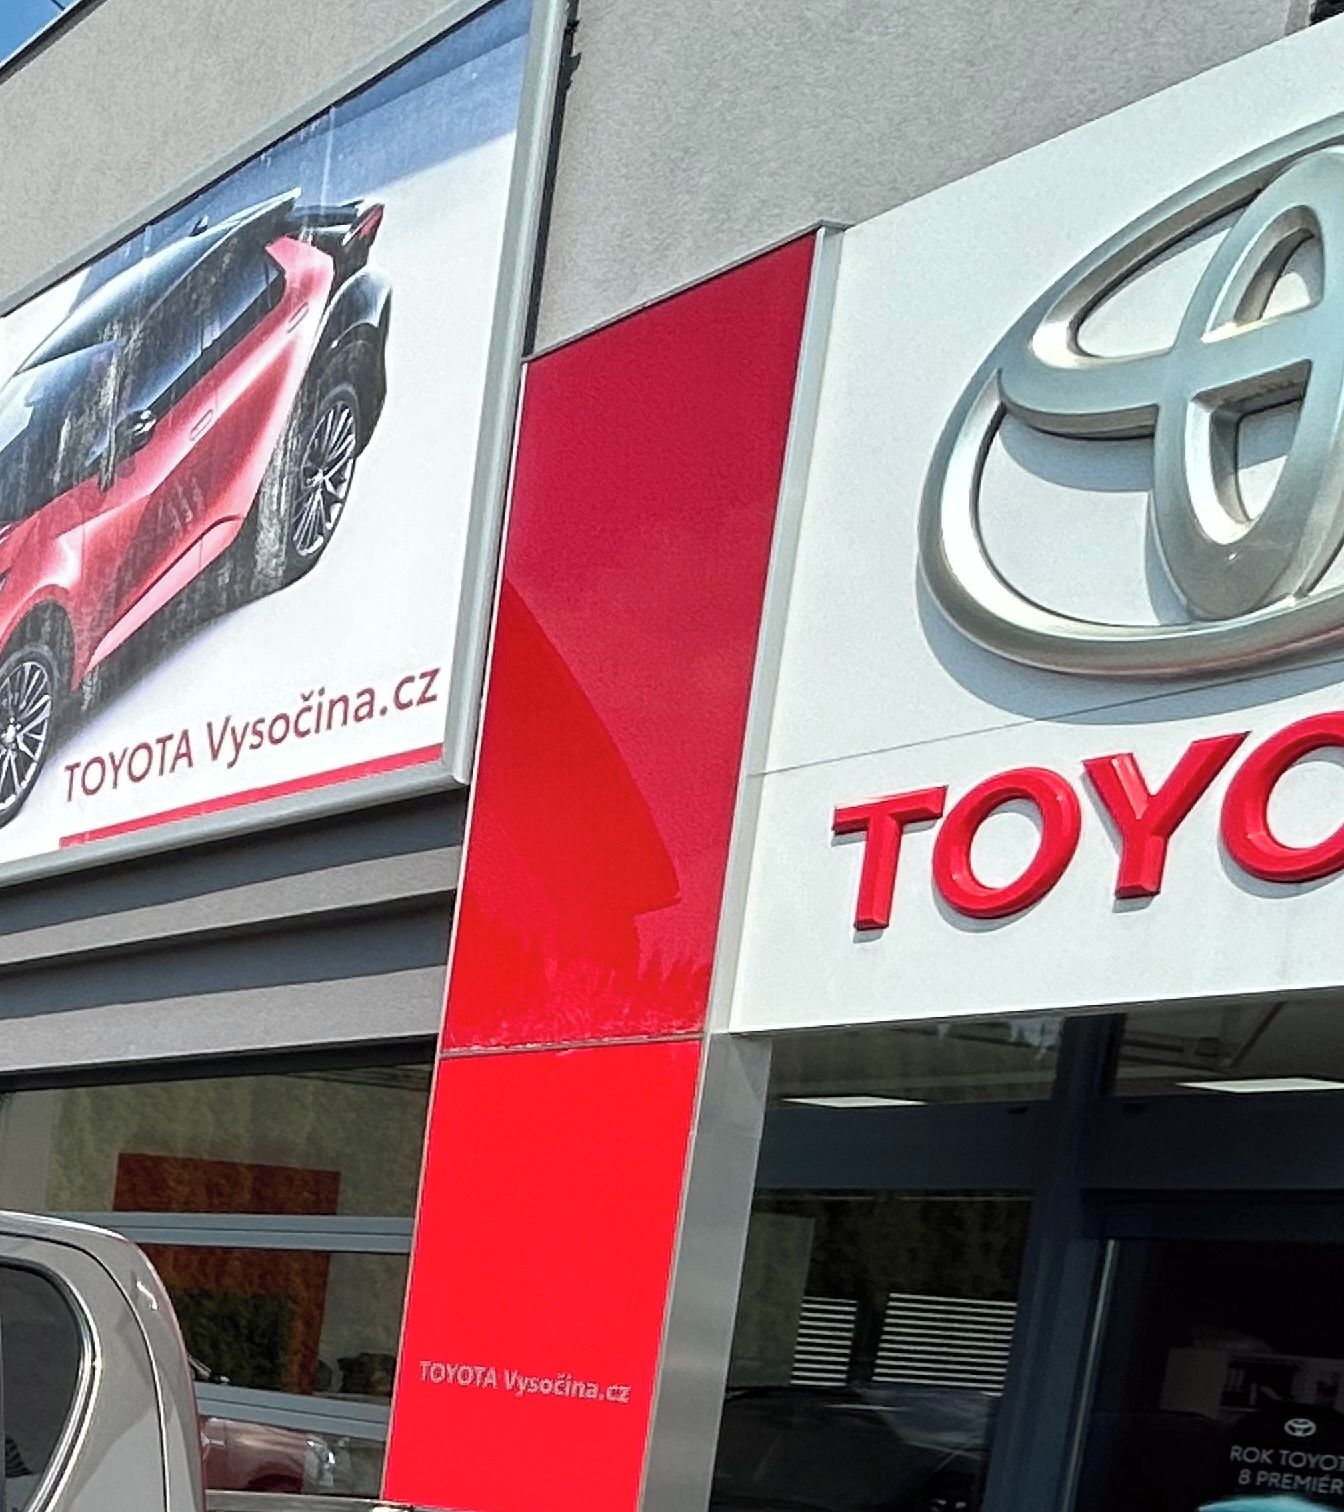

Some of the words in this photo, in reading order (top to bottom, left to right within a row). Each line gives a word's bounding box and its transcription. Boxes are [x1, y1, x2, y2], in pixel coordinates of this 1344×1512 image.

[64, 728, 194, 802] TOYOTA
[206, 667, 441, 769] Vysočina.cz
[419, 1360, 498, 1390] TOYOTA
[502, 1369, 632, 1403] Vysočina.cz
[1230, 1445, 1273, 1465] ROK
[1238, 1468, 1252, 1485] 8
